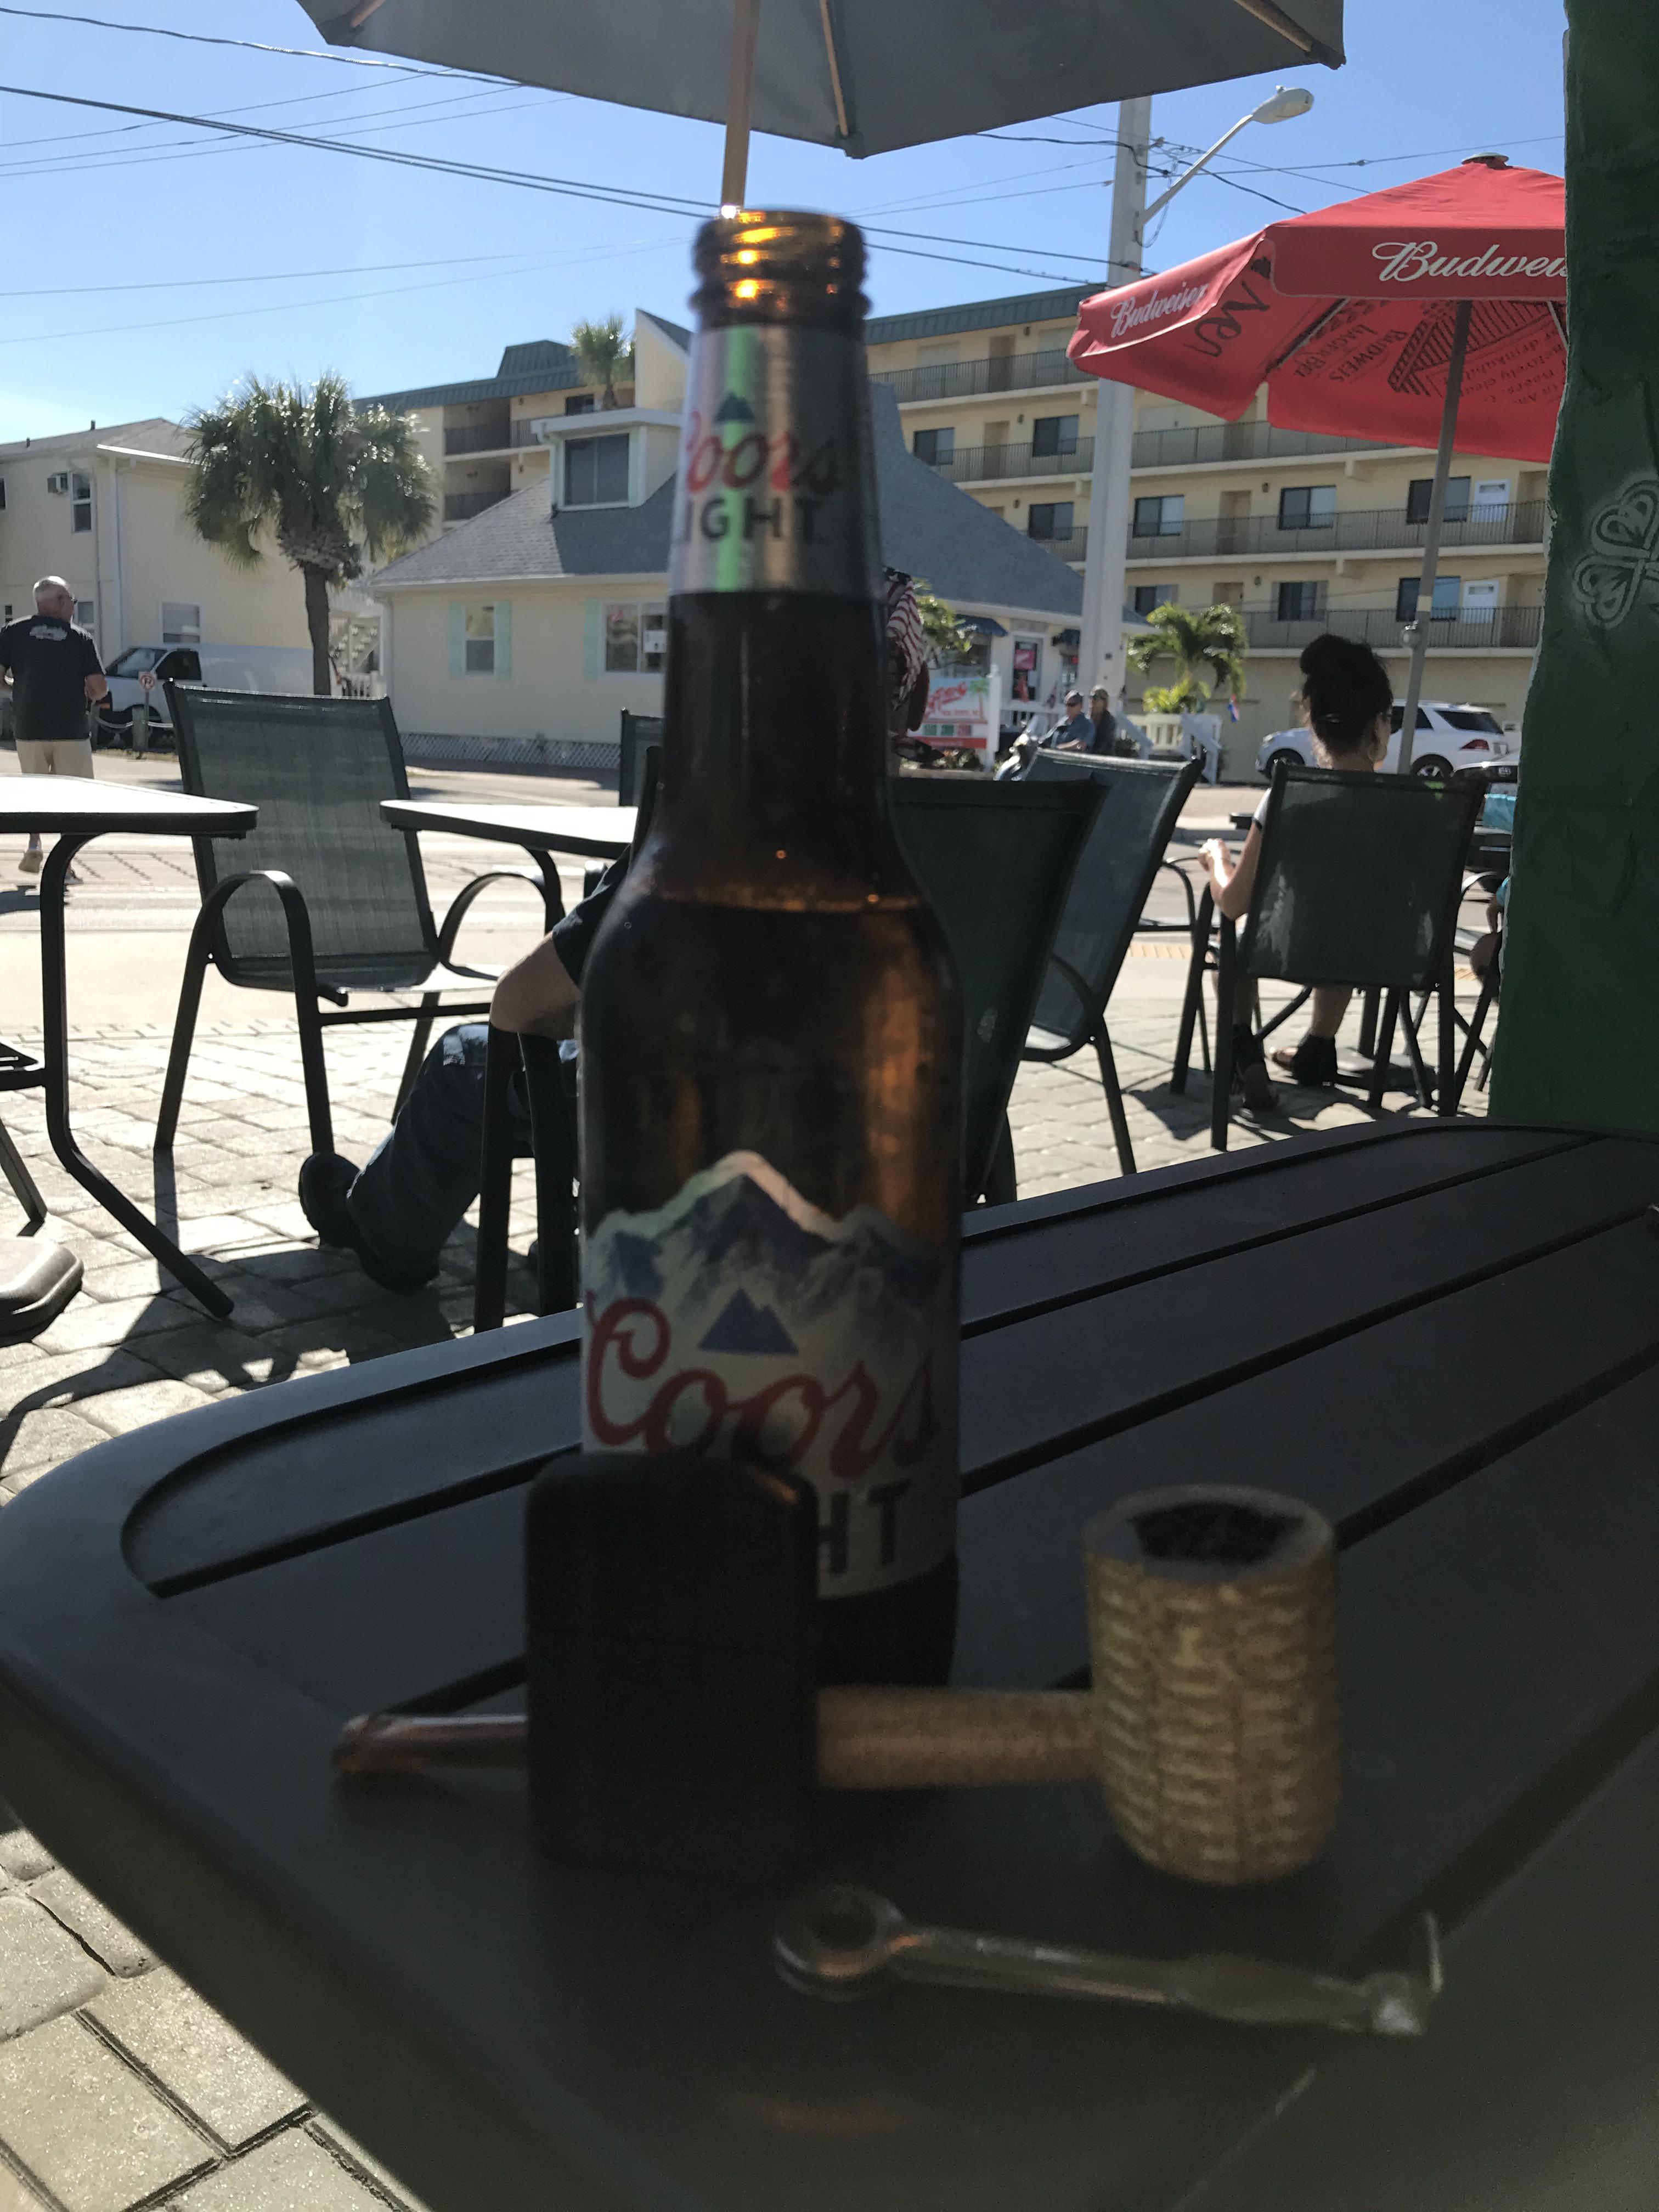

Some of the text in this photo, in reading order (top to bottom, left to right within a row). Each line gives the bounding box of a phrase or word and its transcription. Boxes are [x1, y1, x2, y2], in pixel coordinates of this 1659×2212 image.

[1372, 241, 1567, 281] Budwei
[1110, 281, 1208, 338] Budweiser
[684, 495, 823, 544] IGHT
[586, 1289, 937, 1479] Coors
